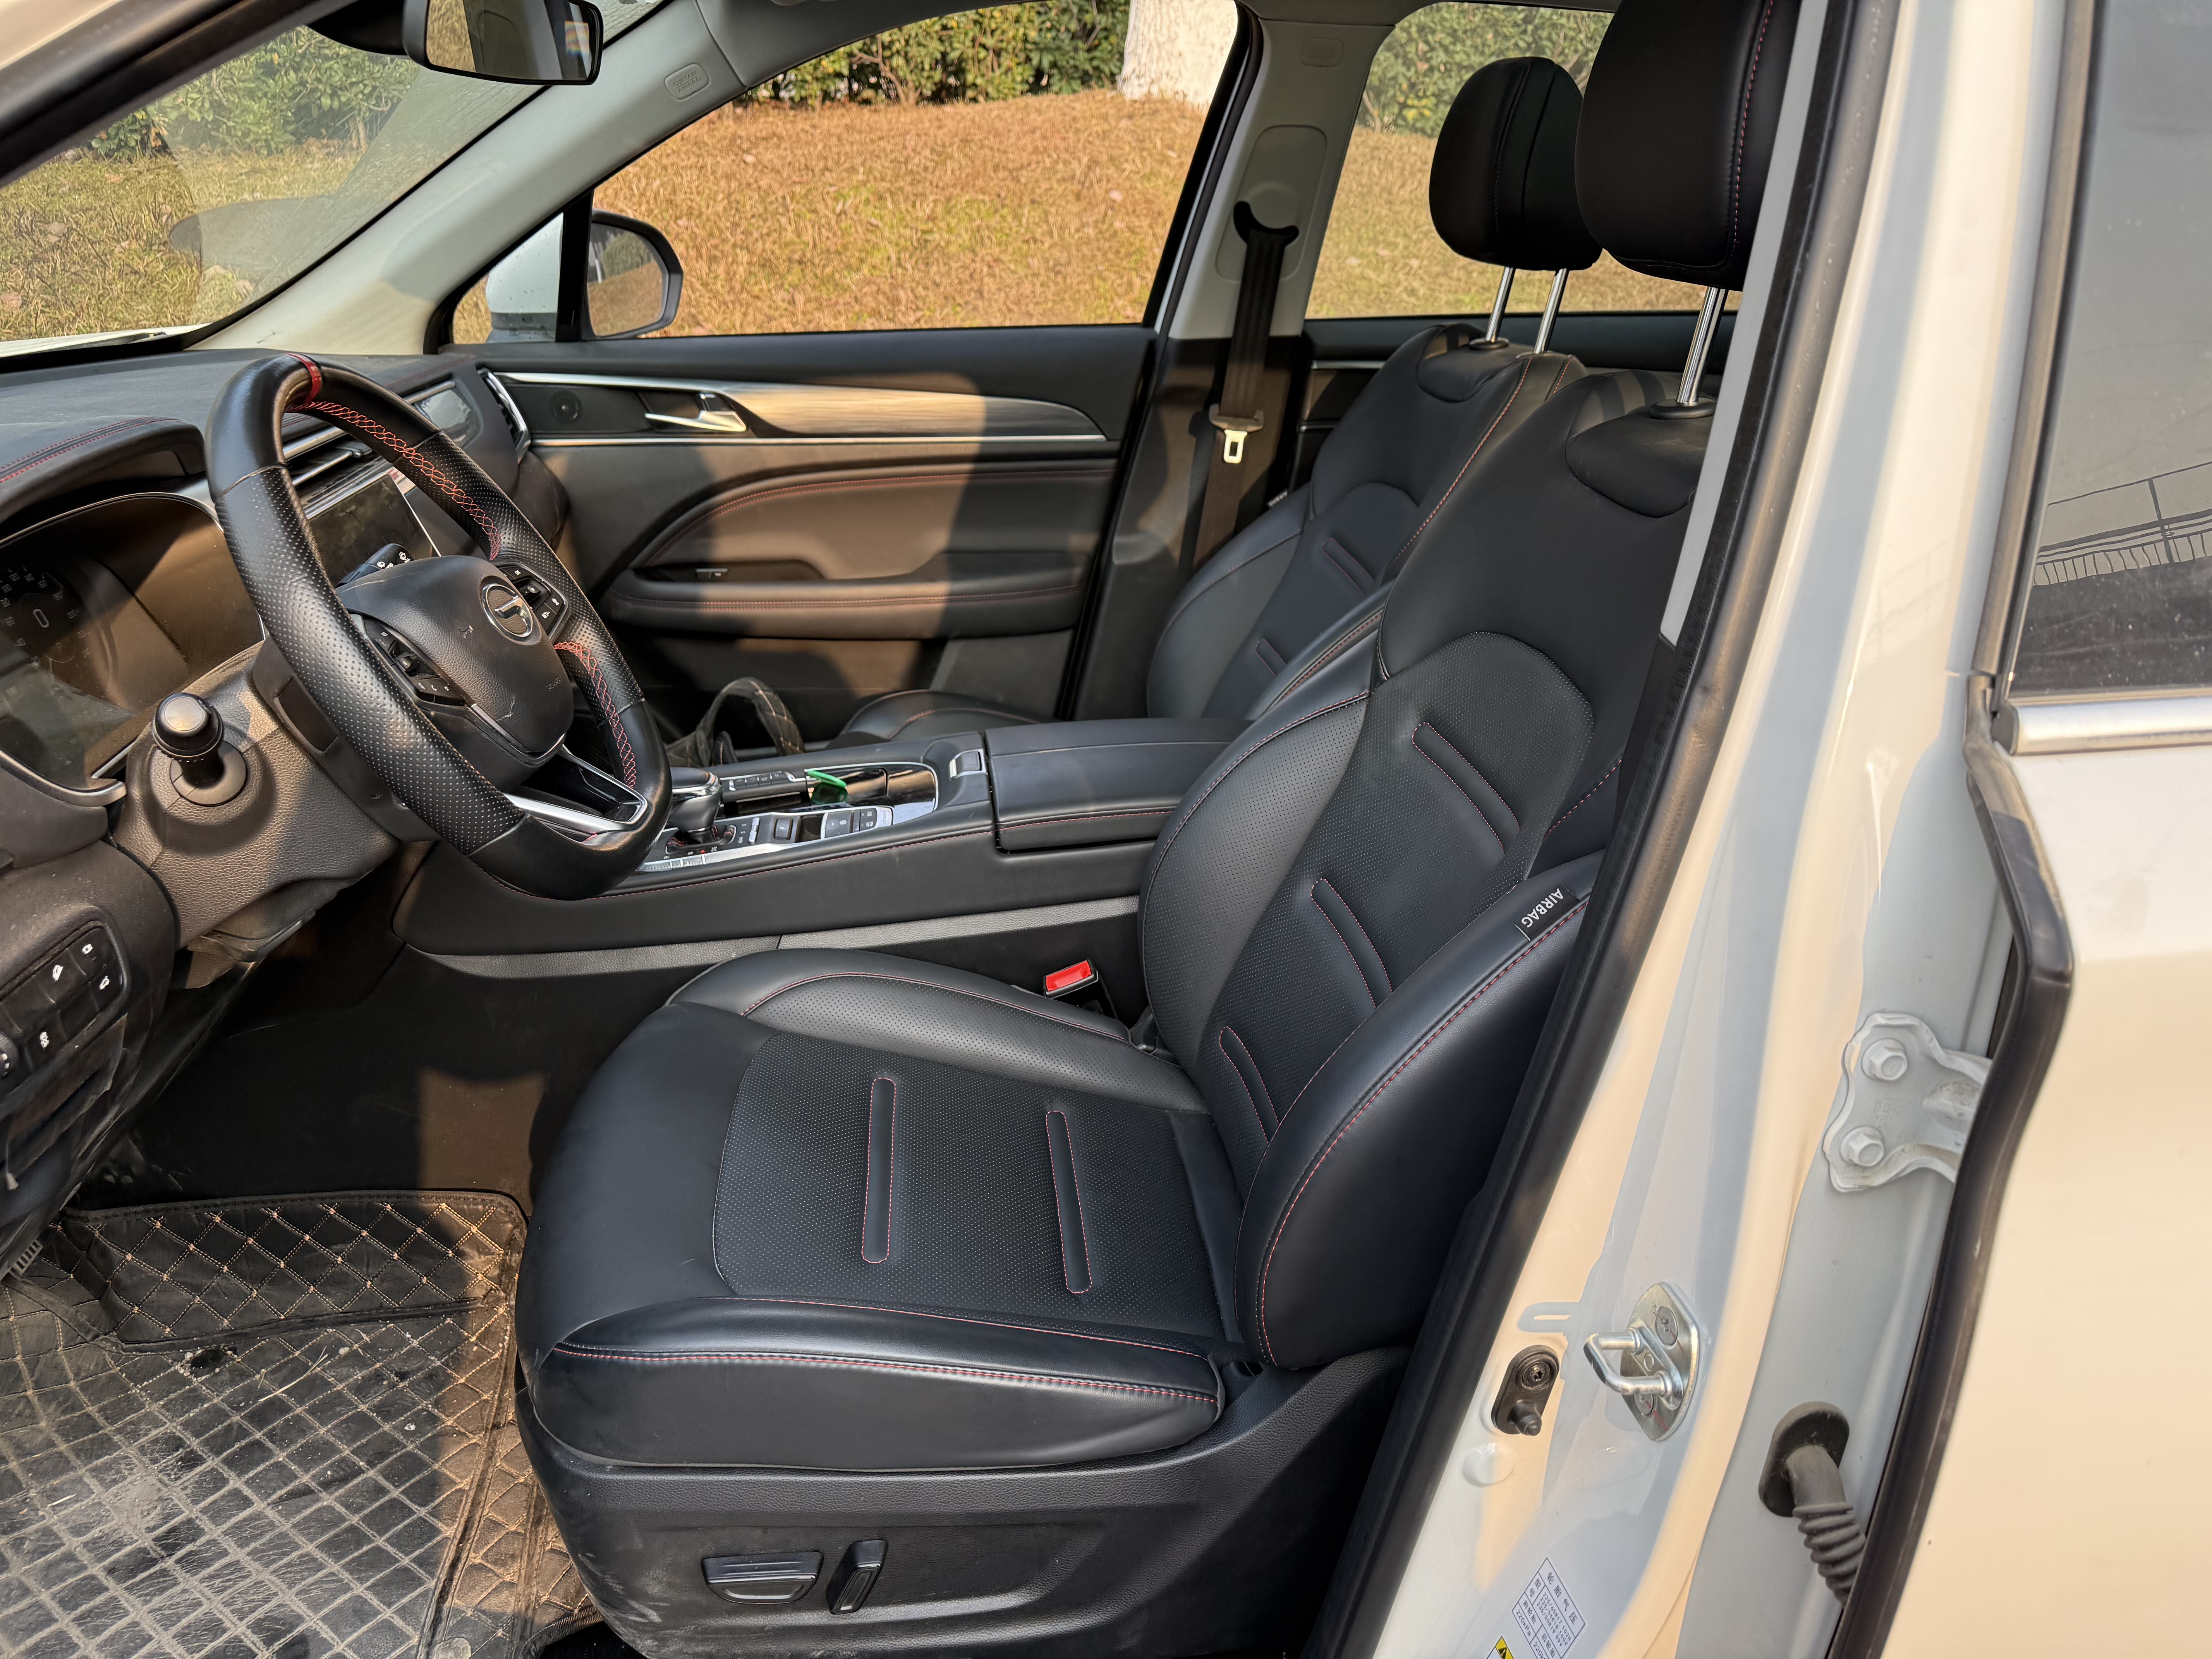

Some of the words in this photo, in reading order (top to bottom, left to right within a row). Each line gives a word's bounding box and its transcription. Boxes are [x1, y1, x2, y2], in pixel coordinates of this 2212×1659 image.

[1521, 888, 1563, 928] AIRBAG
[1543, 1592, 1562, 1624] 225/65R17
[1547, 1572, 1578, 1625] 轮胎气压
[1516, 1609, 1531, 1637] 220kPa
[1533, 1641, 1546, 1659] 220k
